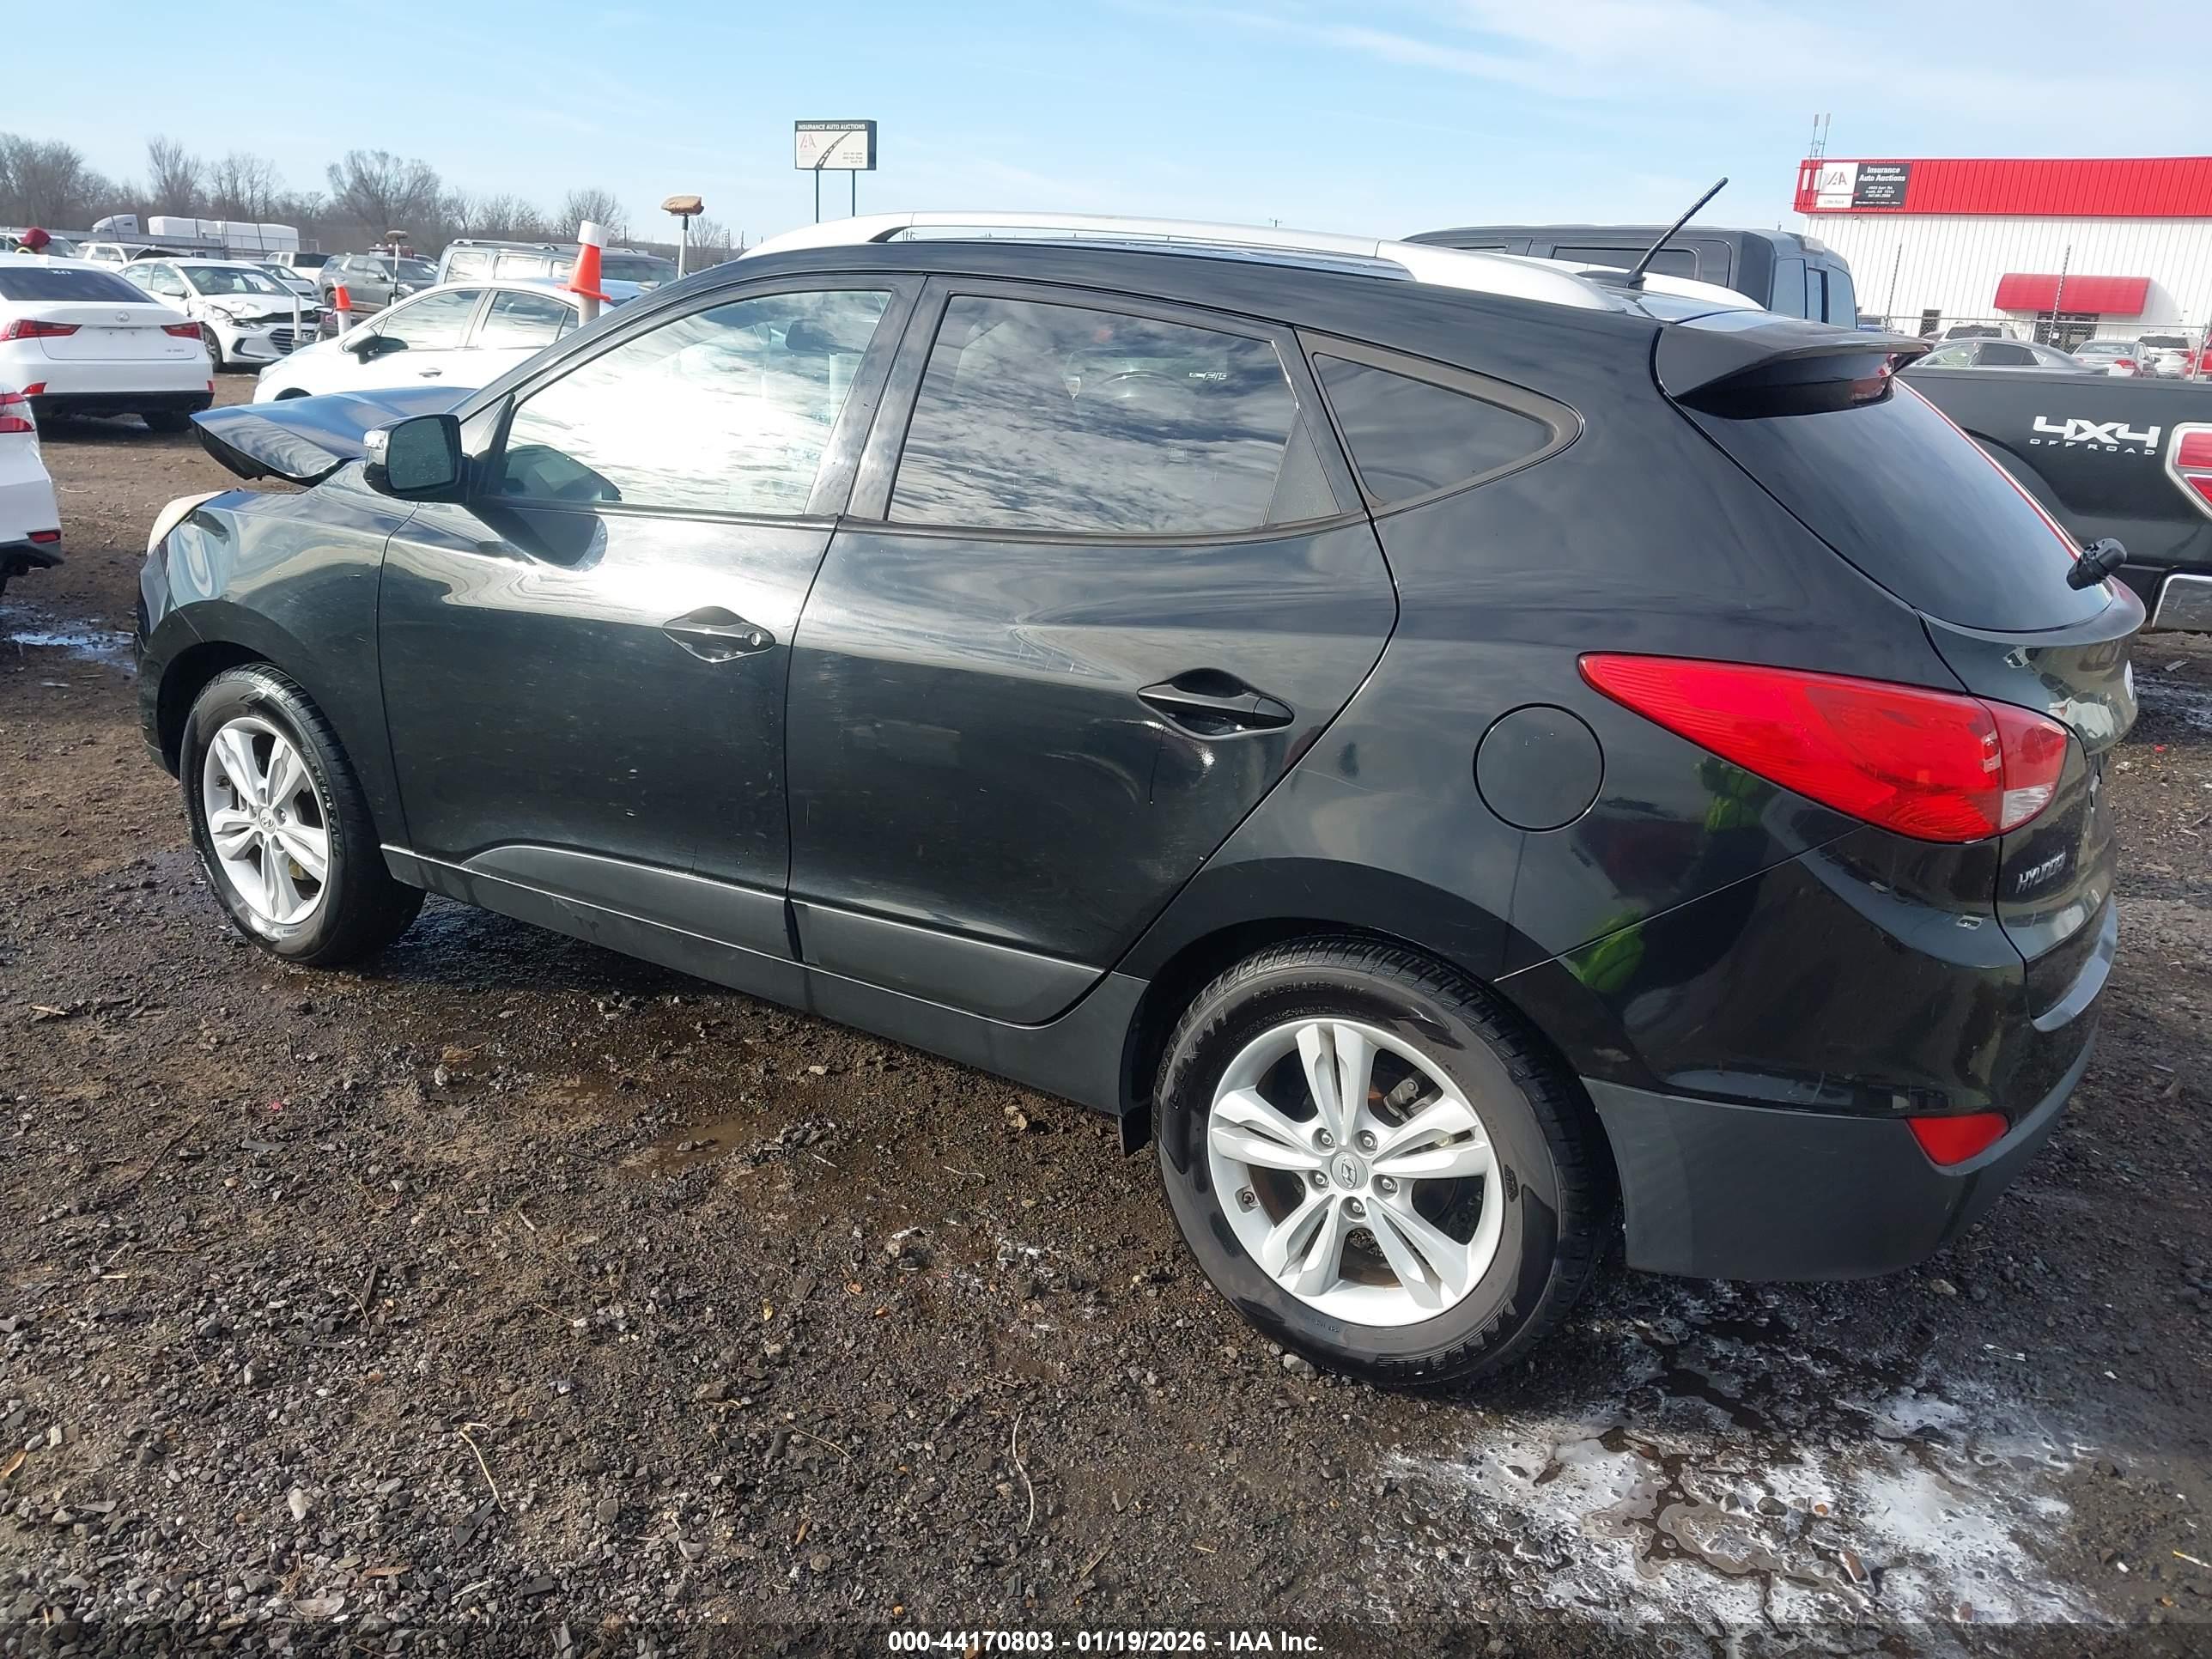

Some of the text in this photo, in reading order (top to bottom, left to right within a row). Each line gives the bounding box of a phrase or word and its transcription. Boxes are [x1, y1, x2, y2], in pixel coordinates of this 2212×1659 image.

[1858, 173, 1875, 182] Auto
[2029, 438, 2156, 456] OFF ROAD
[2015, 851, 2067, 894] HYUNDA
